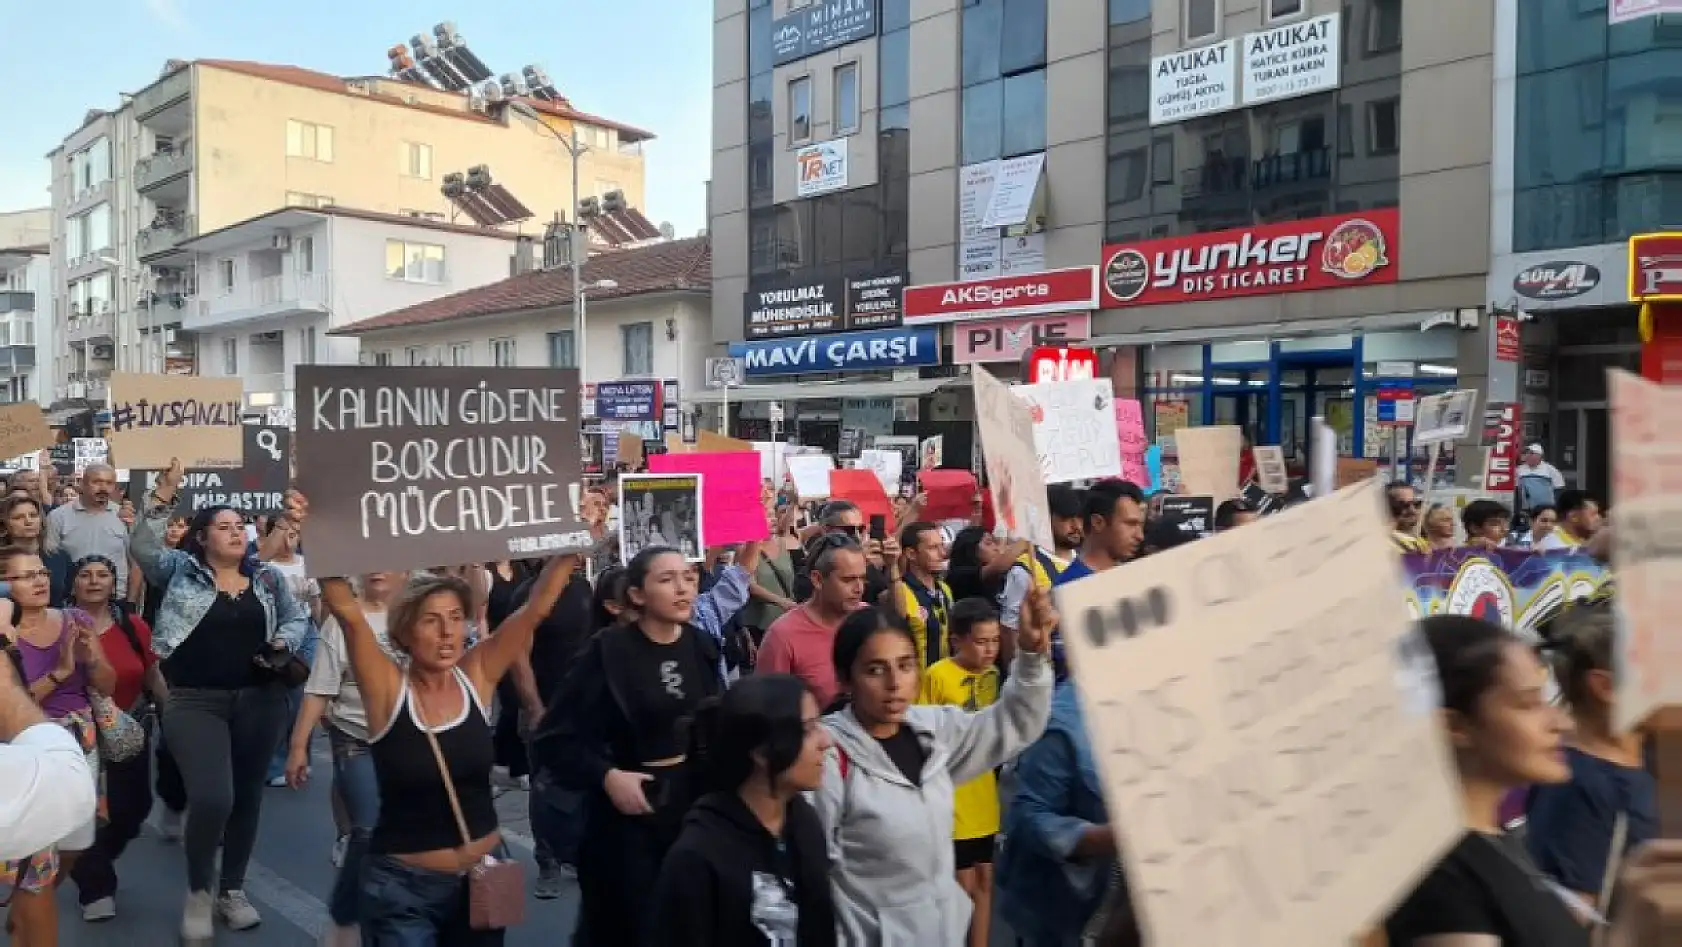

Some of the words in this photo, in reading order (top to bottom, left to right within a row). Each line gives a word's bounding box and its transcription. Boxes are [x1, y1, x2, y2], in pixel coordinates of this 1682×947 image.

[1250, 19, 1331, 56] AVUKAT
[1157, 46, 1228, 78] AVUKAT
[1152, 232, 1324, 288] yunker
[759, 283, 825, 305] YORULMAZ
[1183, 276, 1214, 294] DIŞ
[1220, 264, 1309, 290] TİCARET
[751, 300, 835, 323] MÜHENDİSLİK
[745, 338, 816, 369] MAVİ
[825, 336, 918, 367] ÇARŞI
[312, 385, 450, 431] KALANIN
[458, 380, 567, 425] GİDENE
[371, 435, 554, 483] BORCUDUR
[360, 482, 562, 539] MÜCADELE
